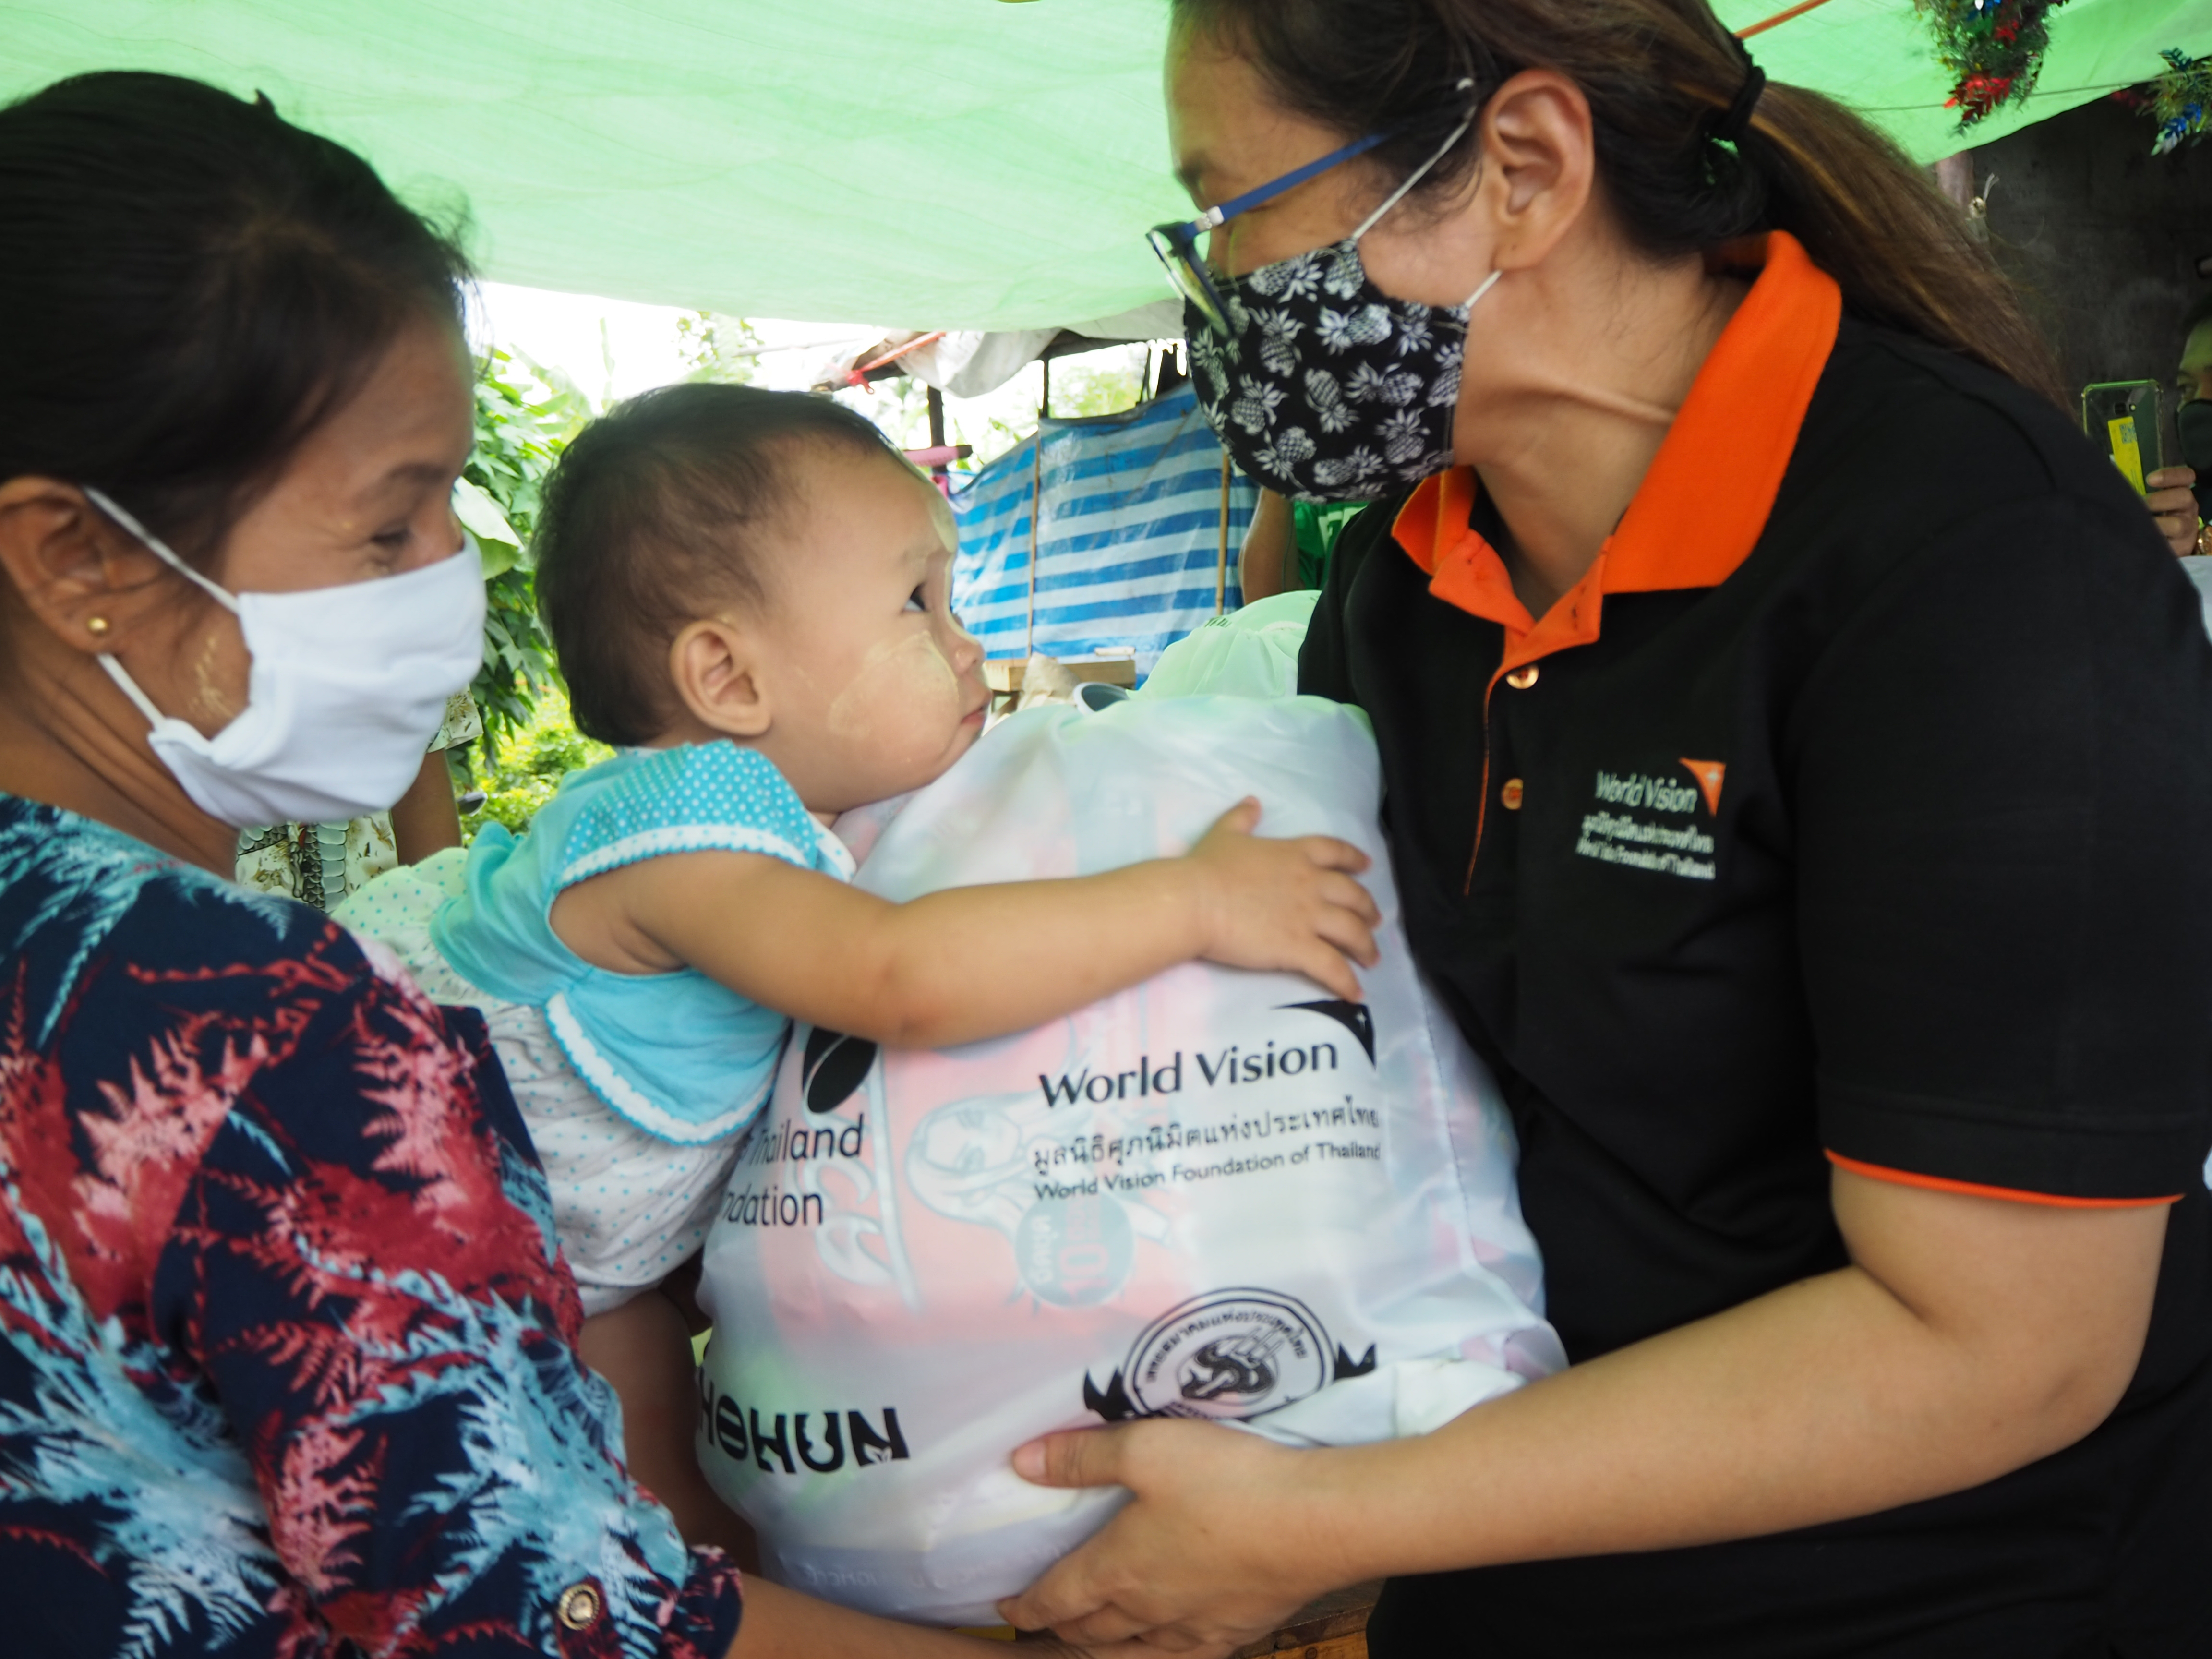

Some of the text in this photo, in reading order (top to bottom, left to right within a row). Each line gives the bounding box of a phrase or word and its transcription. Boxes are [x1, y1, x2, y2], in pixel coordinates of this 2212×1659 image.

[1595, 770, 1698, 813] World Vision
[1038, 1041, 1339, 1107] World Vision
[1033, 1141, 1381, 1202] World Vision Foundation of Thailand
